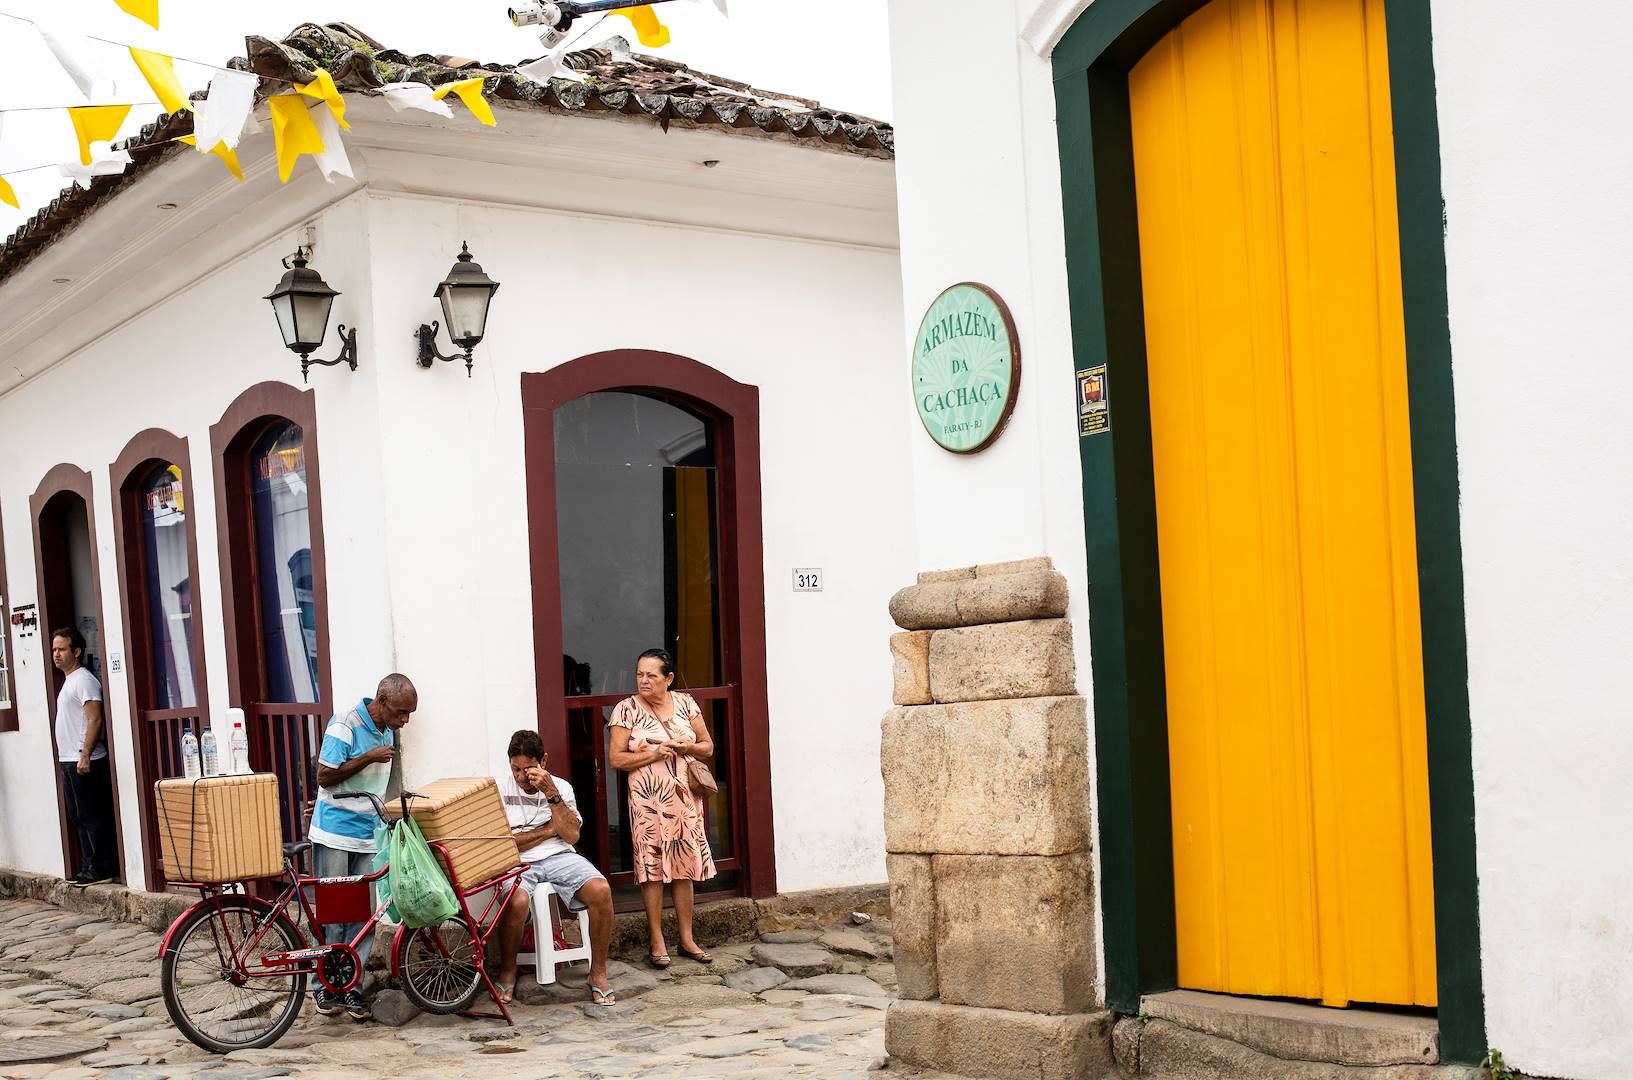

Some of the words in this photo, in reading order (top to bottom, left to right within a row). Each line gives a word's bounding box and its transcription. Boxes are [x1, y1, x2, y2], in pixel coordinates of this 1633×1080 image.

[922, 307, 998, 357] ARMAZÉM
[951, 359, 969, 374] DA
[1085, 380, 1100, 394] BM
[923, 382, 1002, 413] CACHAÇA
[798, 574, 818, 588] 312
